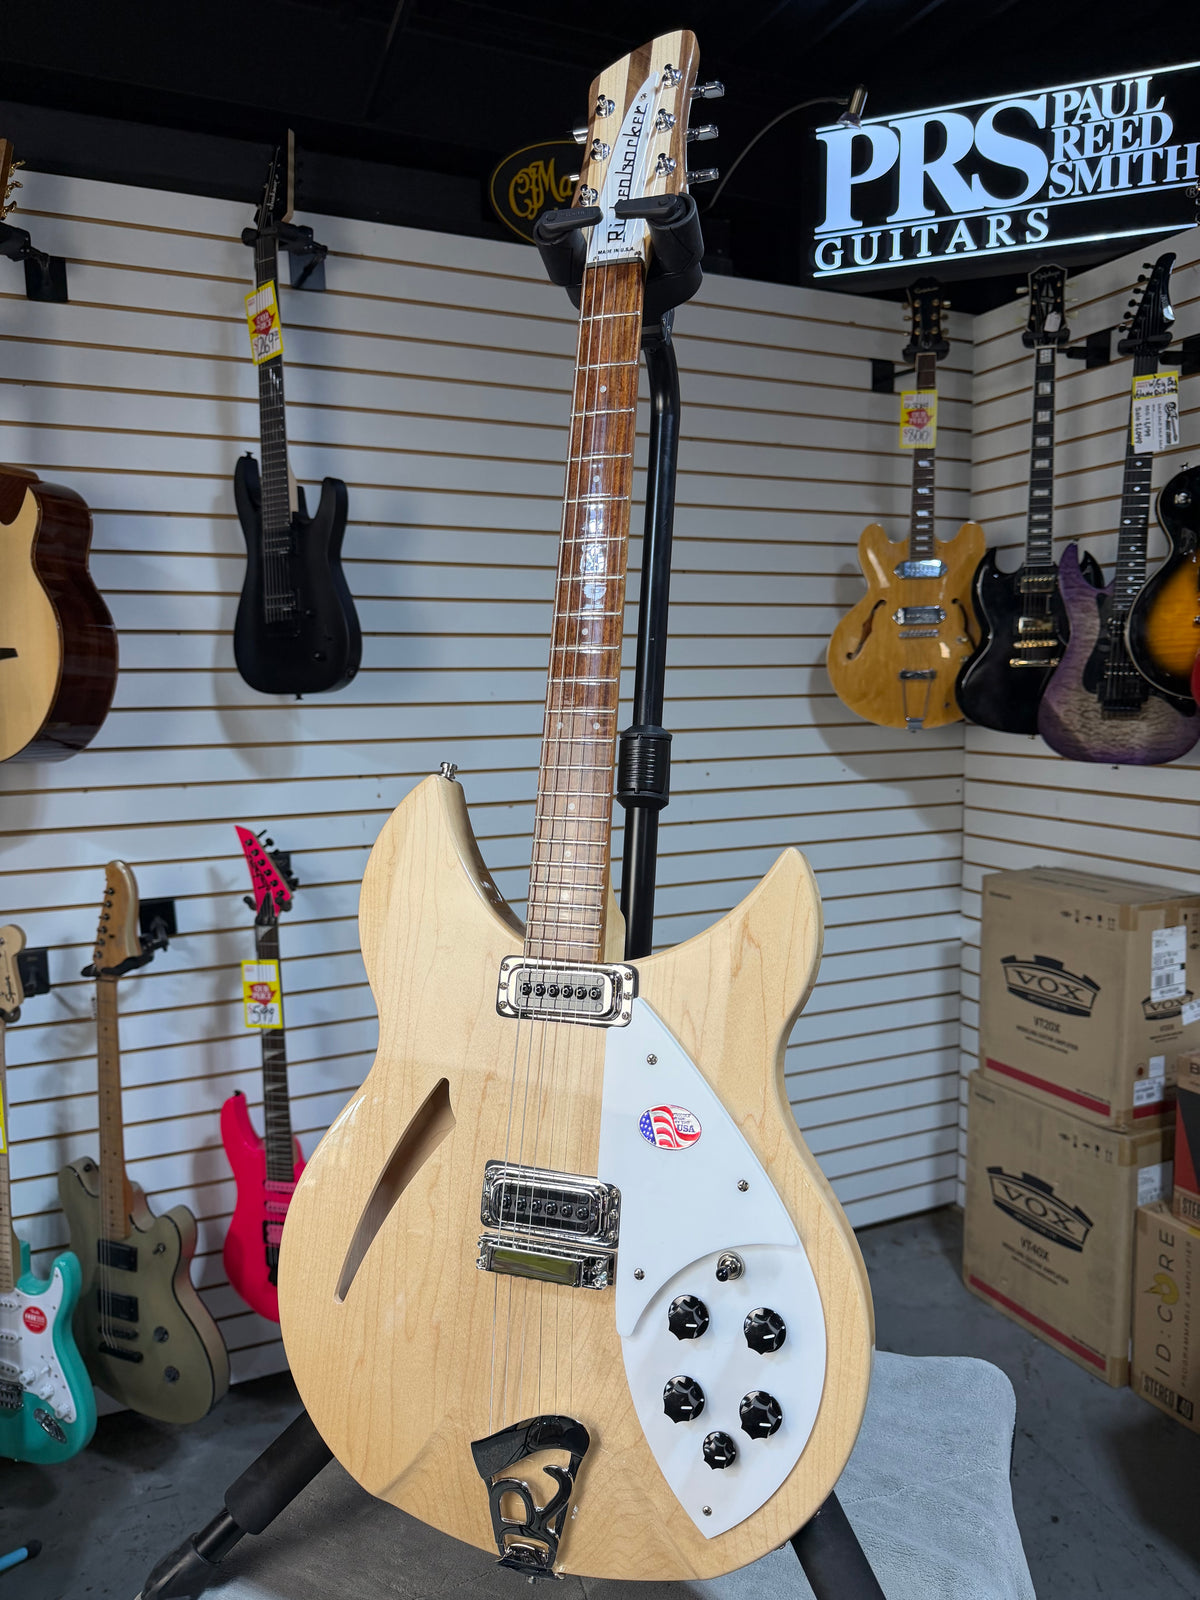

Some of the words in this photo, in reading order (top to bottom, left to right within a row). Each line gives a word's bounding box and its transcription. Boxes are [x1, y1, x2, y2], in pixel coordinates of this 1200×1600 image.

[1052, 77, 1166, 128] PAUL
[1051, 112, 1174, 163] REED
[608, 102, 648, 243] Rienbacker
[815, 94, 1049, 233] PRS
[1048, 142, 1200, 199] SMITH
[814, 207, 1049, 271] GUITARS
[1012, 969, 1085, 1003] VOX
[677, 1125, 695, 1133] USA
[1002, 1184, 1075, 1234] VOX
